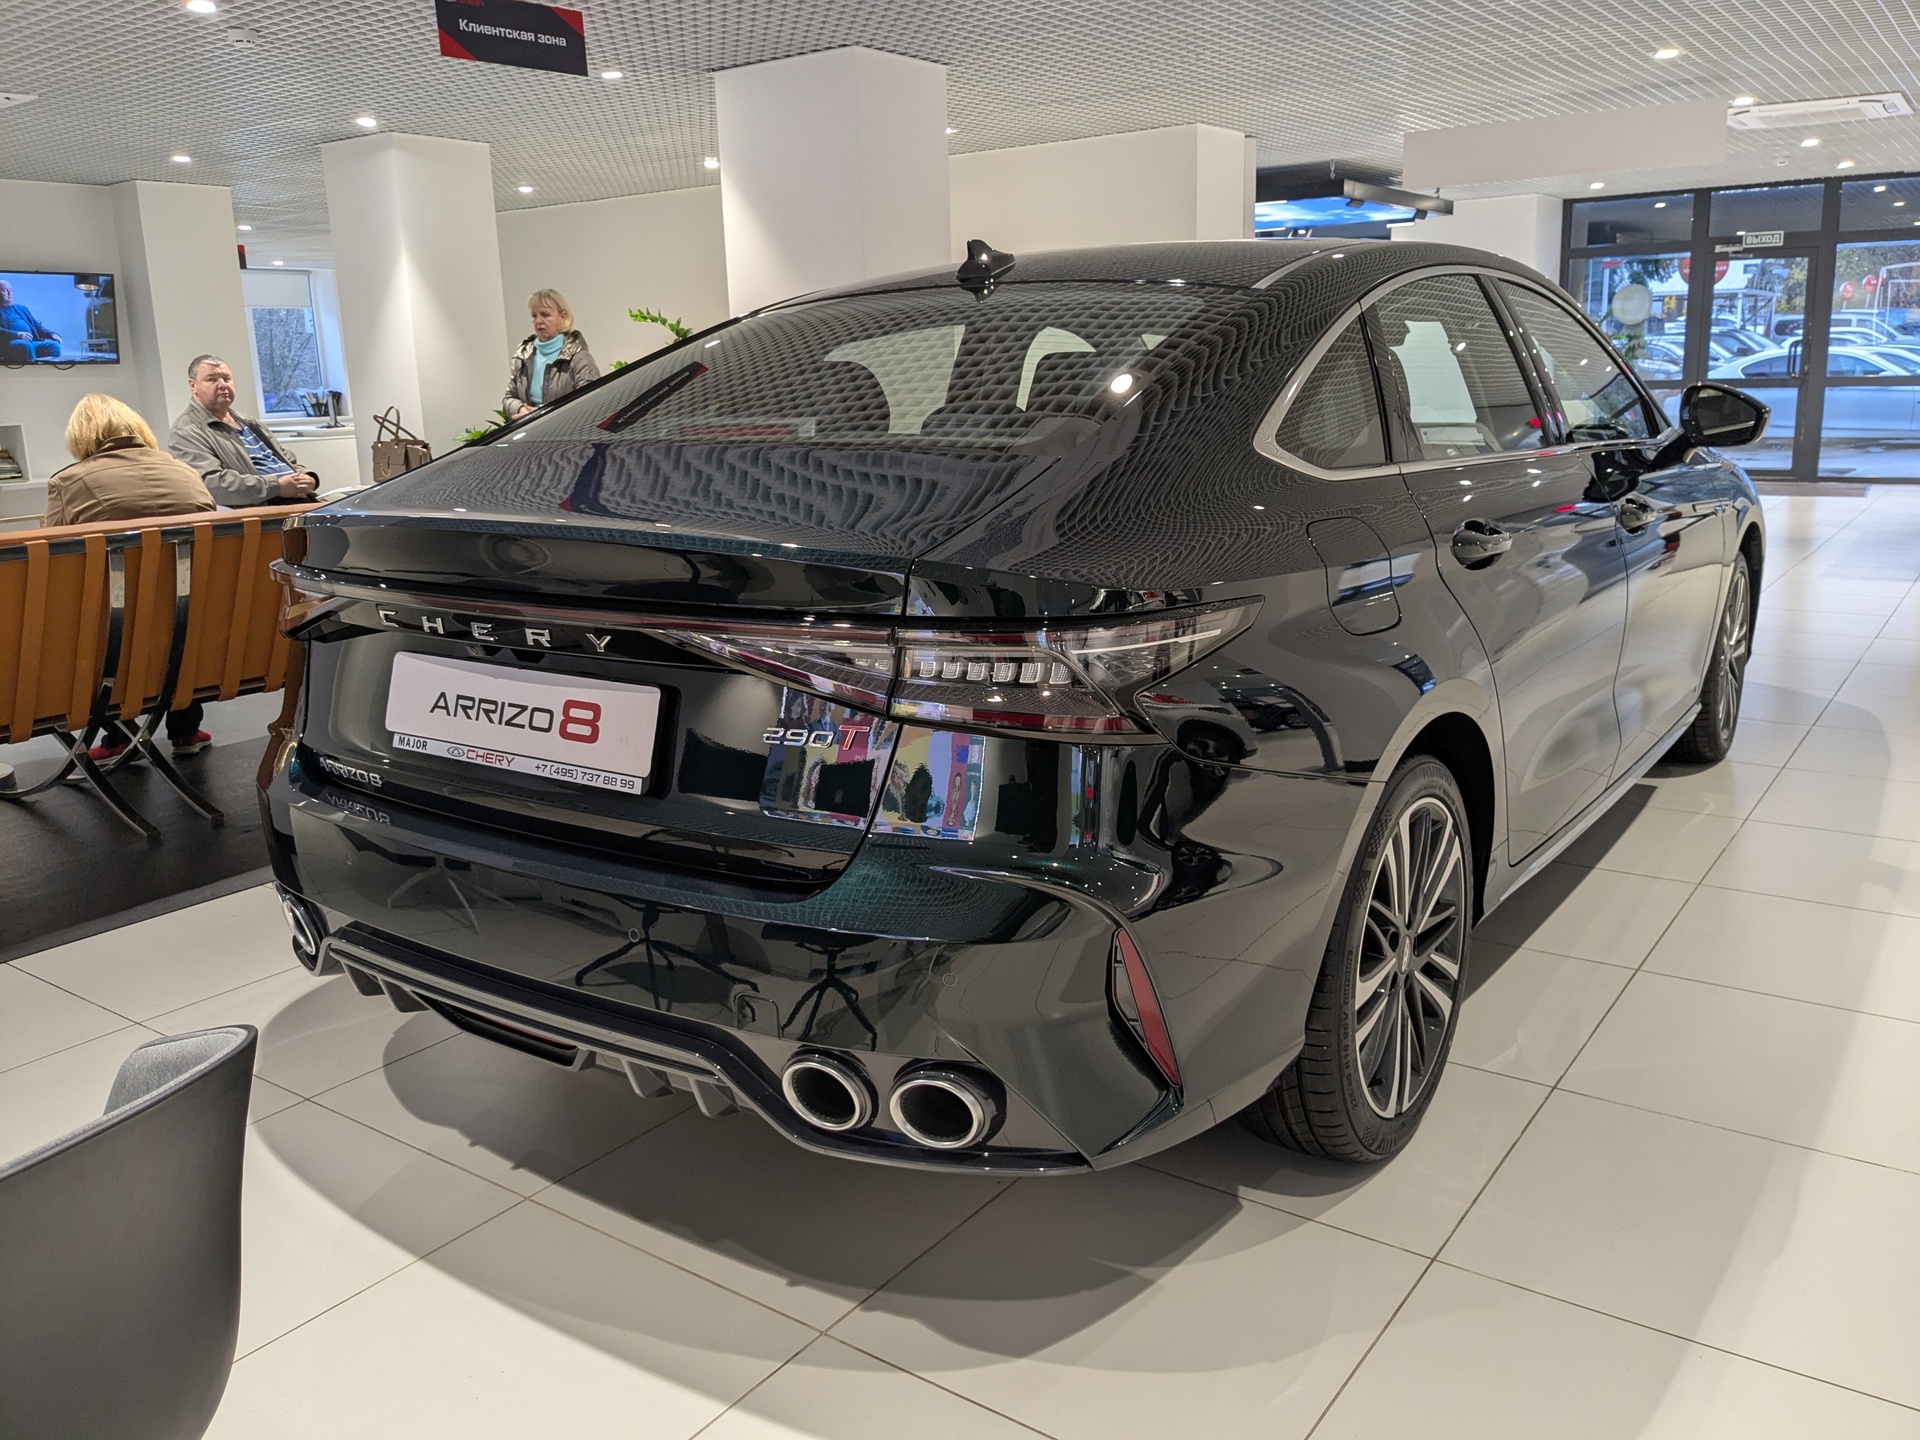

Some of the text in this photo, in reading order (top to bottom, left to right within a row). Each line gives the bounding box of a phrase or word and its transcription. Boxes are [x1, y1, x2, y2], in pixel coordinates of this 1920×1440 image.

[459, 18, 567, 47] Клиентская зона
[1746, 234, 1780, 245] ВЫХОД
[379, 610, 612, 652] CHERY
[397, 735, 635, 791] MAJOR CHERY +7 (495) 737 88 99
